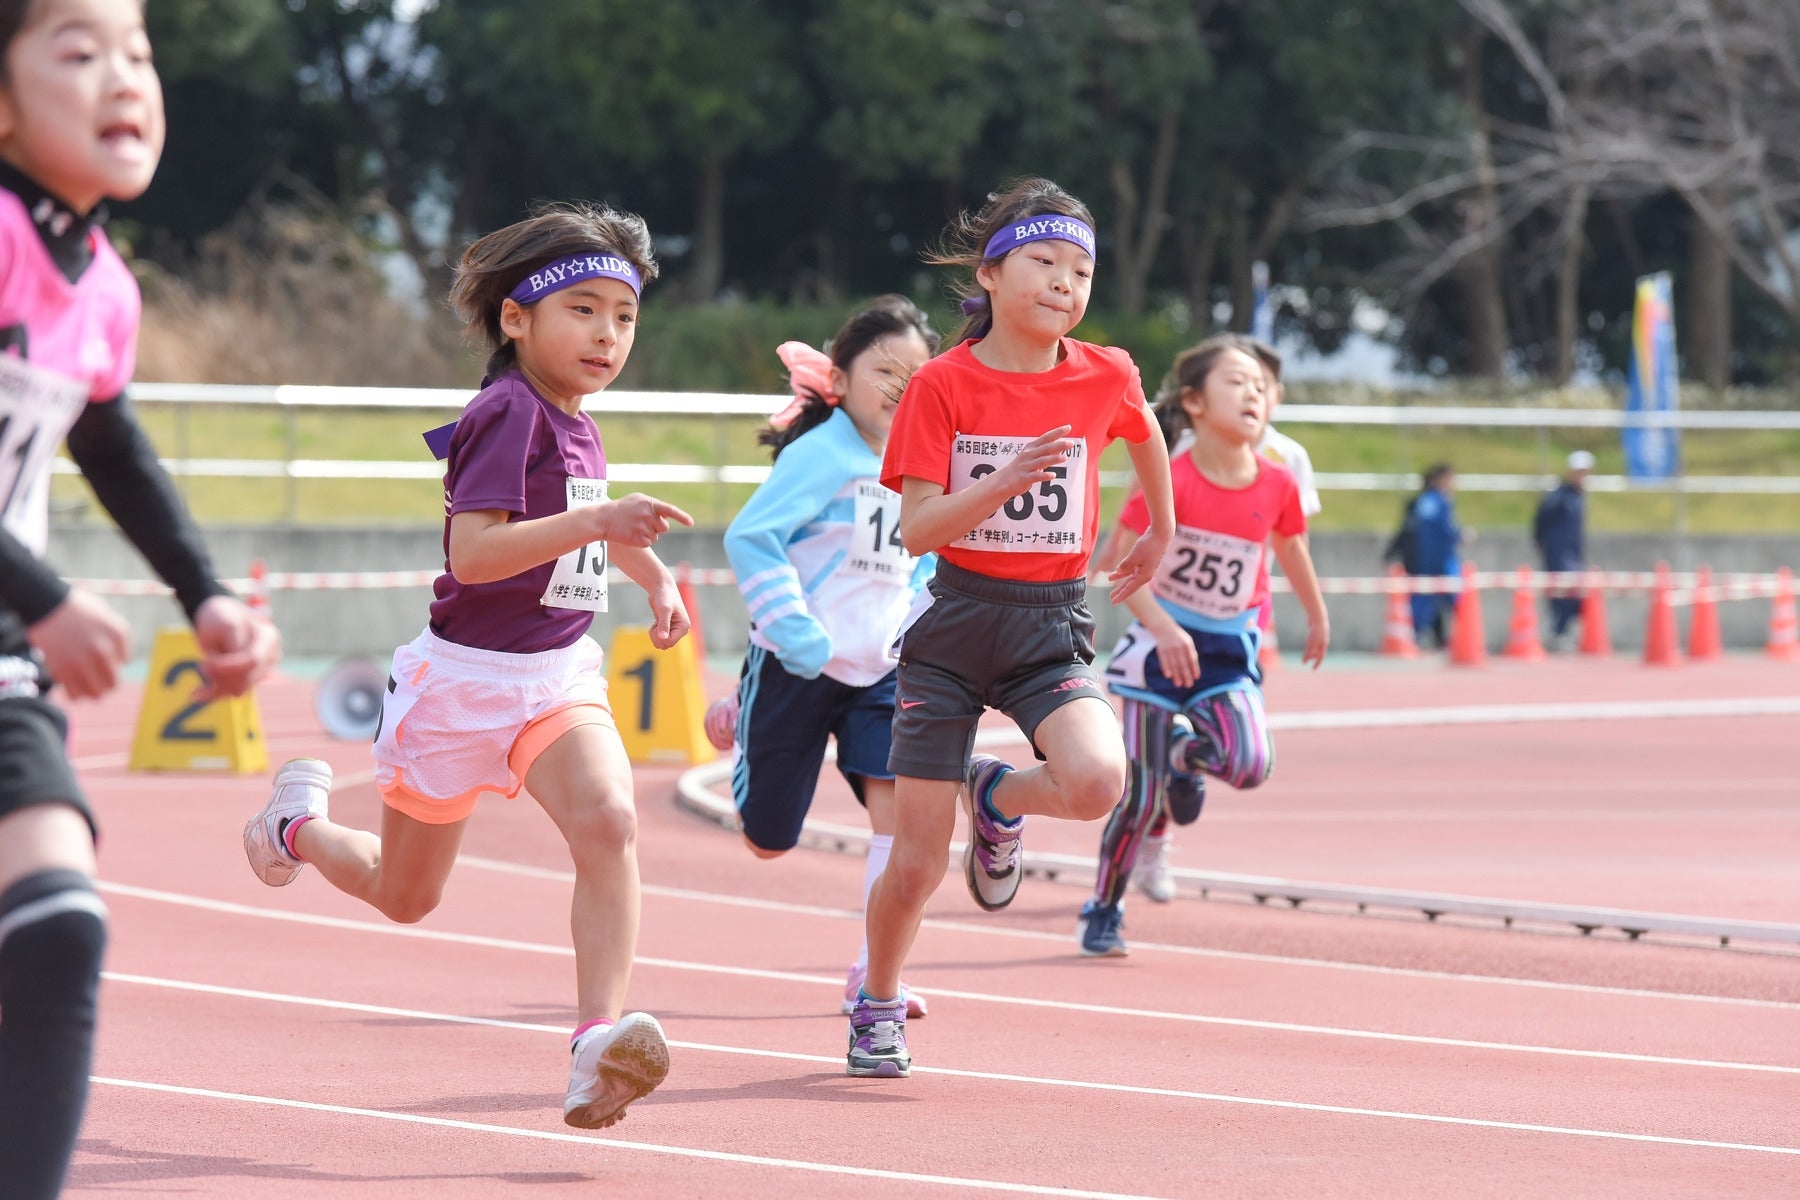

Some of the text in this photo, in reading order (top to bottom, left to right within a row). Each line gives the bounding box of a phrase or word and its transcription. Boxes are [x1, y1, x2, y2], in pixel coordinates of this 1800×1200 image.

[1014, 221, 1050, 241] BAY
[528, 256, 632, 293] BAY KIDS
[1061, 444, 1081, 458] 017
[1169, 547, 1244, 597] 253
[162, 659, 216, 740] 2
[621, 657, 655, 732] 1
